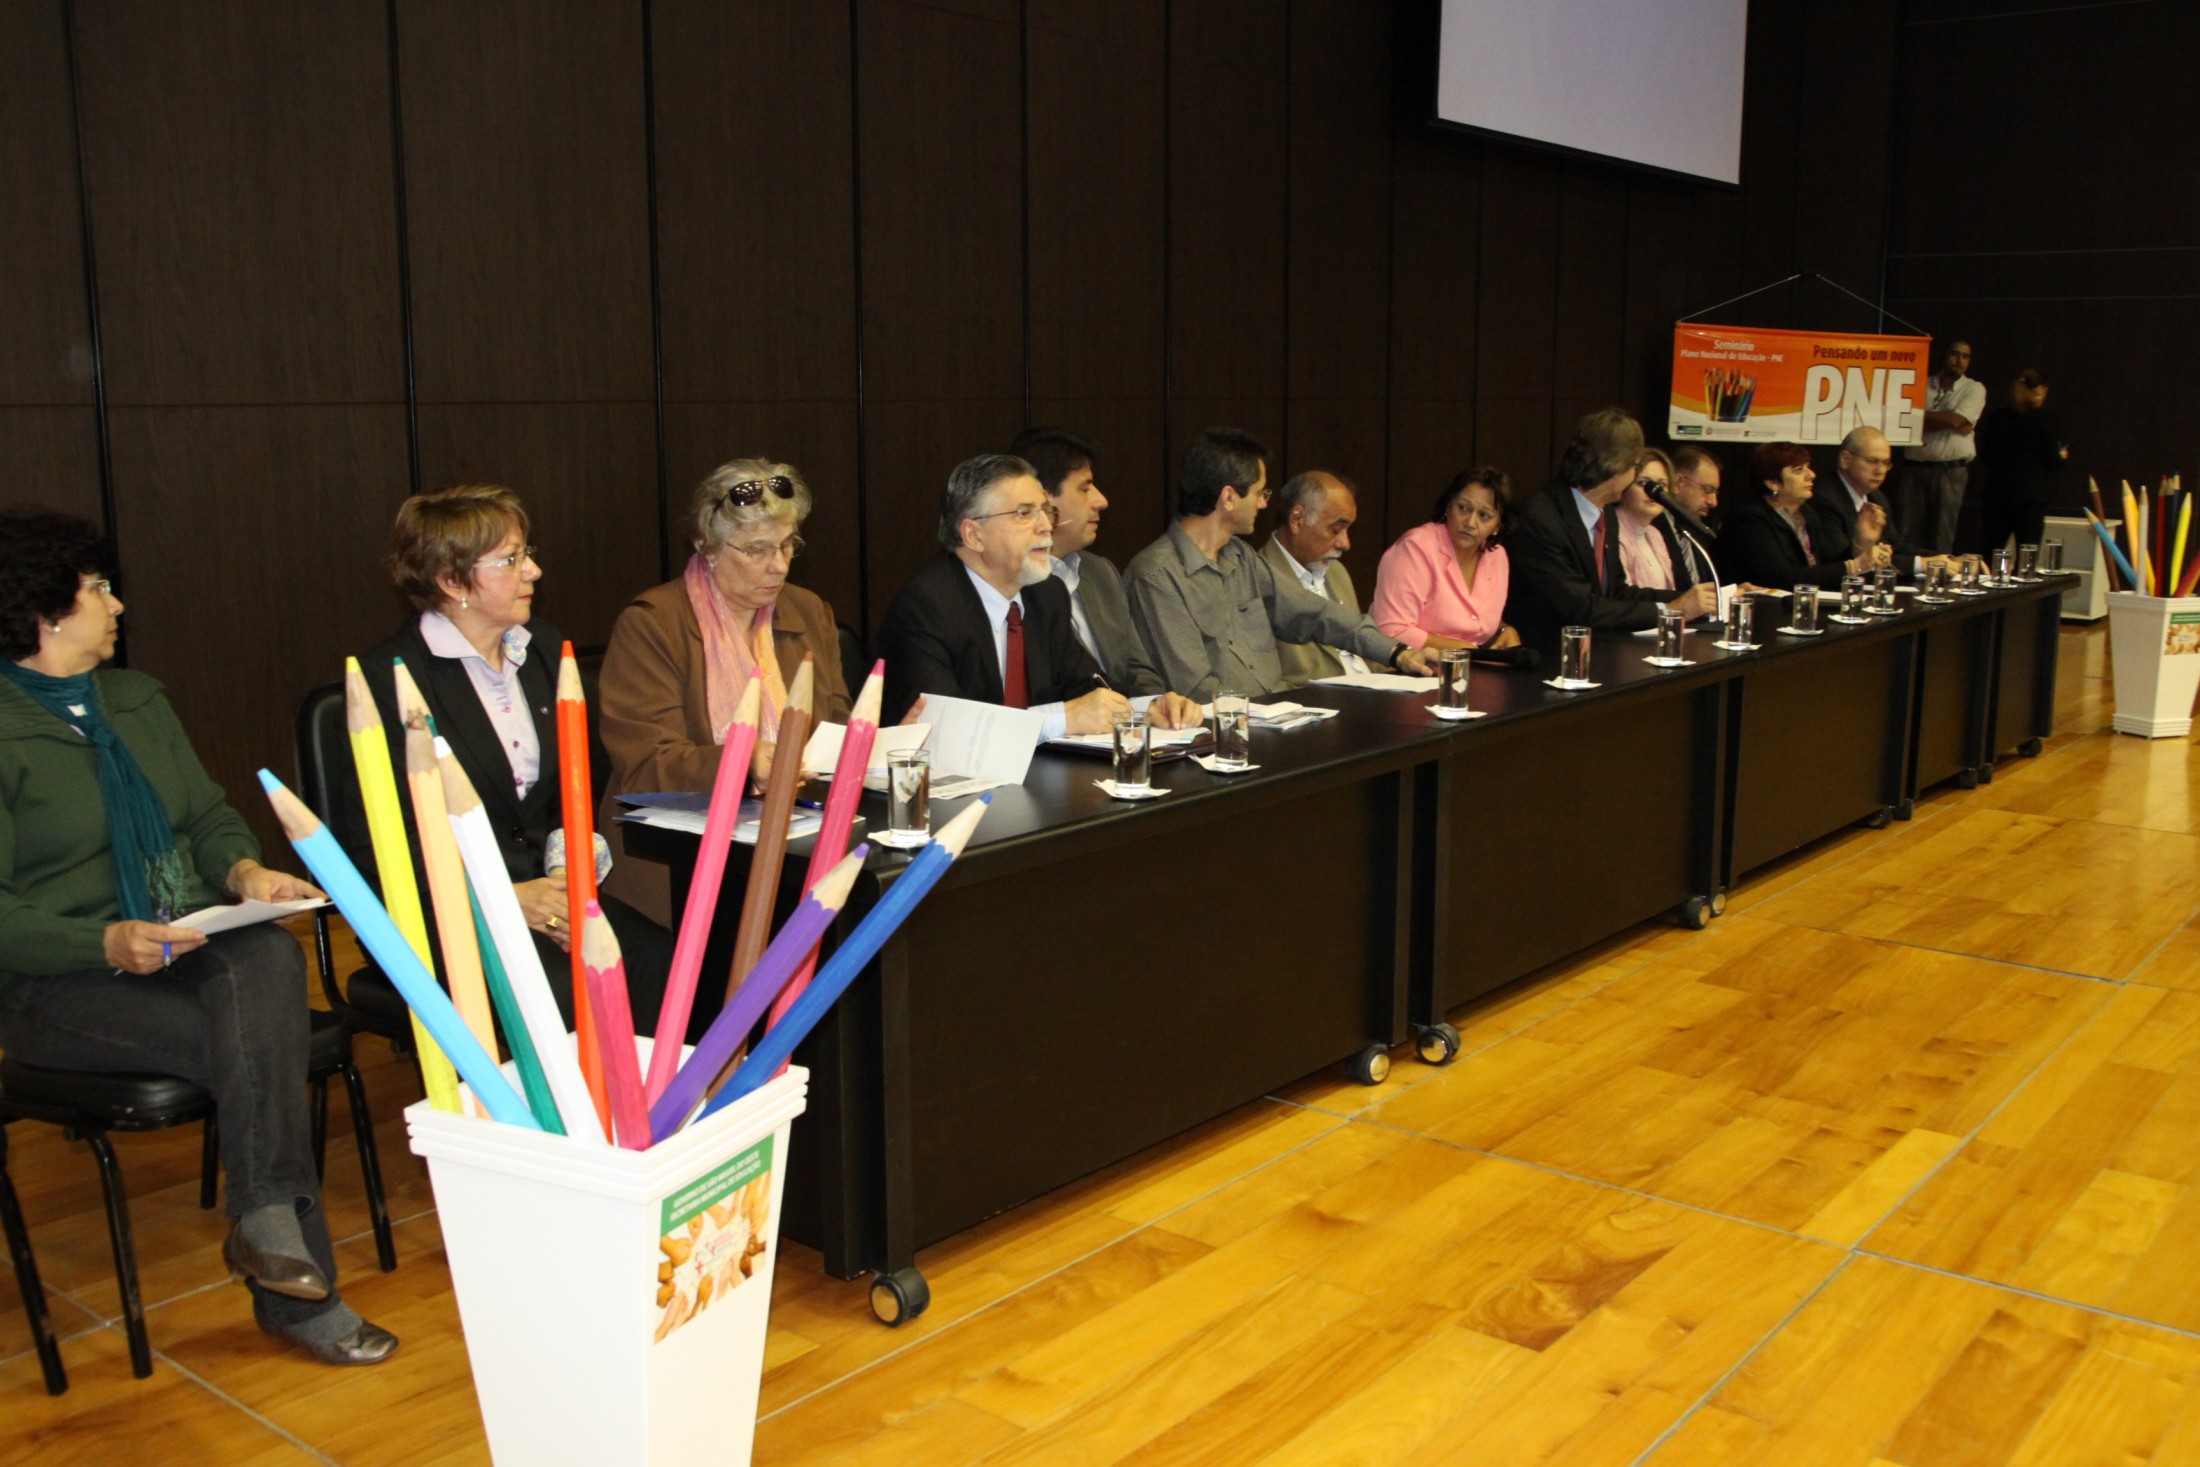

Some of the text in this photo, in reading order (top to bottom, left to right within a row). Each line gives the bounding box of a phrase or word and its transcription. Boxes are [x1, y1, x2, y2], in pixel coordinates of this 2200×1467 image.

[1680, 349, 1699, 357] Plano
[1700, 351, 1728, 359] Nacional
[1738, 353, 1766, 362] Educação
[1813, 345, 1916, 362] Pensando um novo
[1800, 364, 1917, 442] PNE
